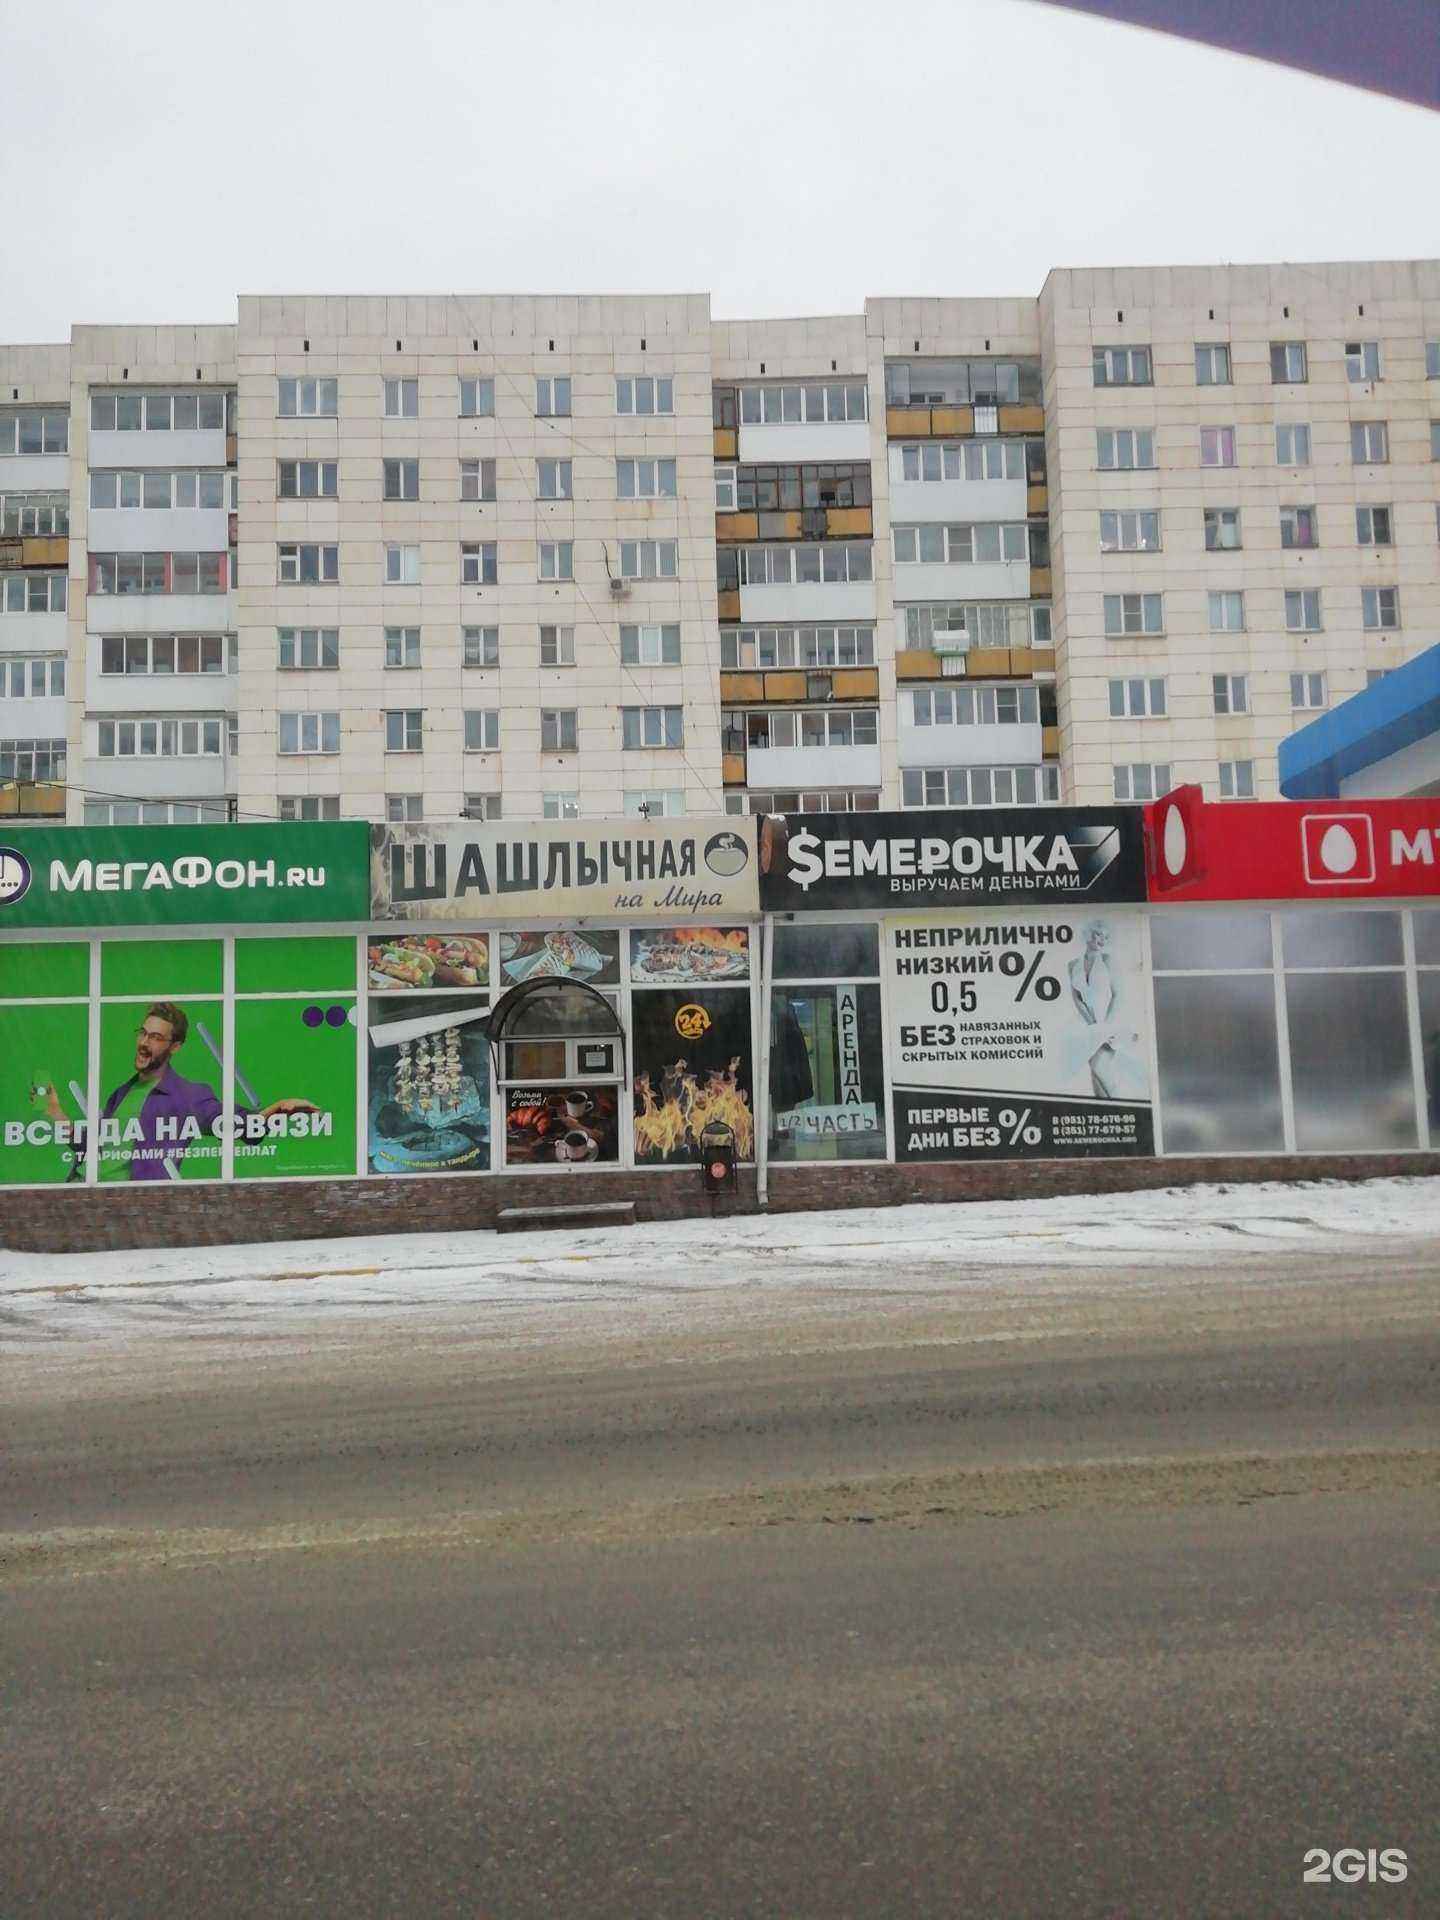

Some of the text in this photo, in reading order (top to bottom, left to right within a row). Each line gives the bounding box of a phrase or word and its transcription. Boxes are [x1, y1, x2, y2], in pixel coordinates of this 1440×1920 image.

[1391, 829, 1440, 865] М
[391, 839, 696, 903] ШАШЛЫЧНАЯ
[890, 873, 1081, 892] ВЫРУЧАЕМ ДЕНЬГАМИ
[614, 885, 722, 914] на Мира
[895, 925, 1073, 948] НЕПРИЛИЧНО
[896, 950, 1061, 1002] НИЗКИЙ %
[931, 981, 977, 1016] 0,5
[900, 1021, 1041, 1047] БЕЗ НАВЯЗАННЫХ
[961, 1035, 1042, 1046] СТРАХОВОК И
[840, 994, 860, 1105] АРЕНДА
[902, 1047, 1043, 1062] СКРЫТЫХ КОМИССИЙ
[4, 1112, 333, 1147] ВСЕГДА НА СВЯЗИ
[807, 1113, 874, 1133] ЧАСТЬ
[907, 1108, 990, 1125] ПЕРВЫЕ
[907, 1108, 1042, 1151] ДНИ БЕЗ %
[62, 1151, 73, 1163] С
